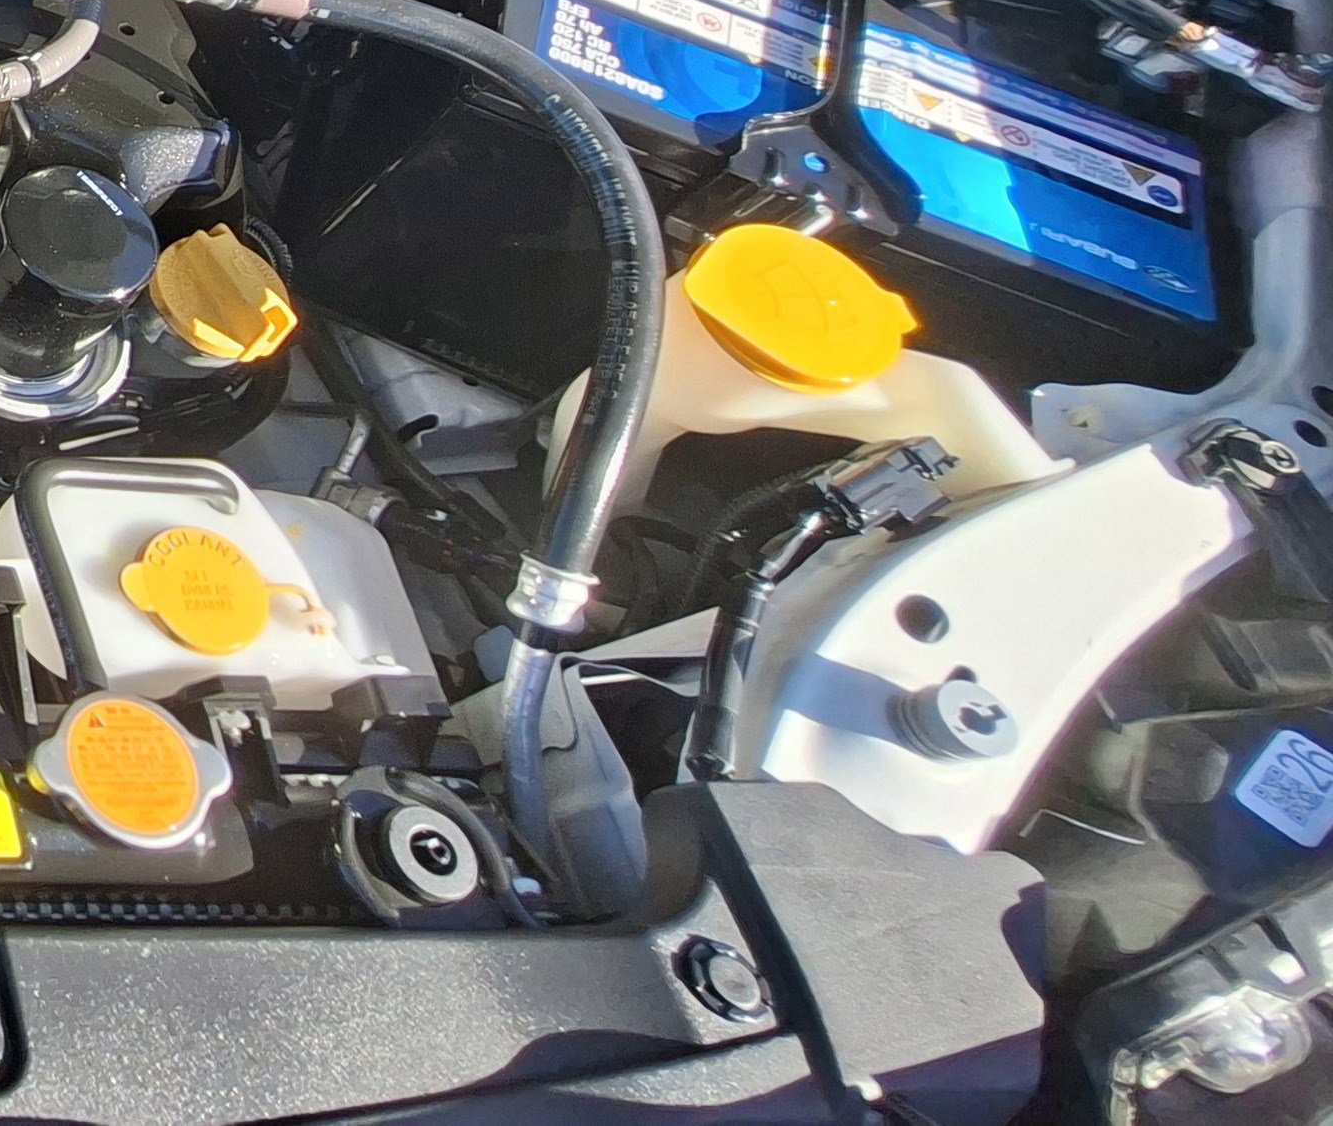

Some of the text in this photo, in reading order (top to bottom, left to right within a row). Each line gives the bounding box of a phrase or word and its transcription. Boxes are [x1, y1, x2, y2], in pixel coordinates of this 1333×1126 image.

[553, 21, 584, 43] 120
[550, 33, 620, 69] CCA 750
